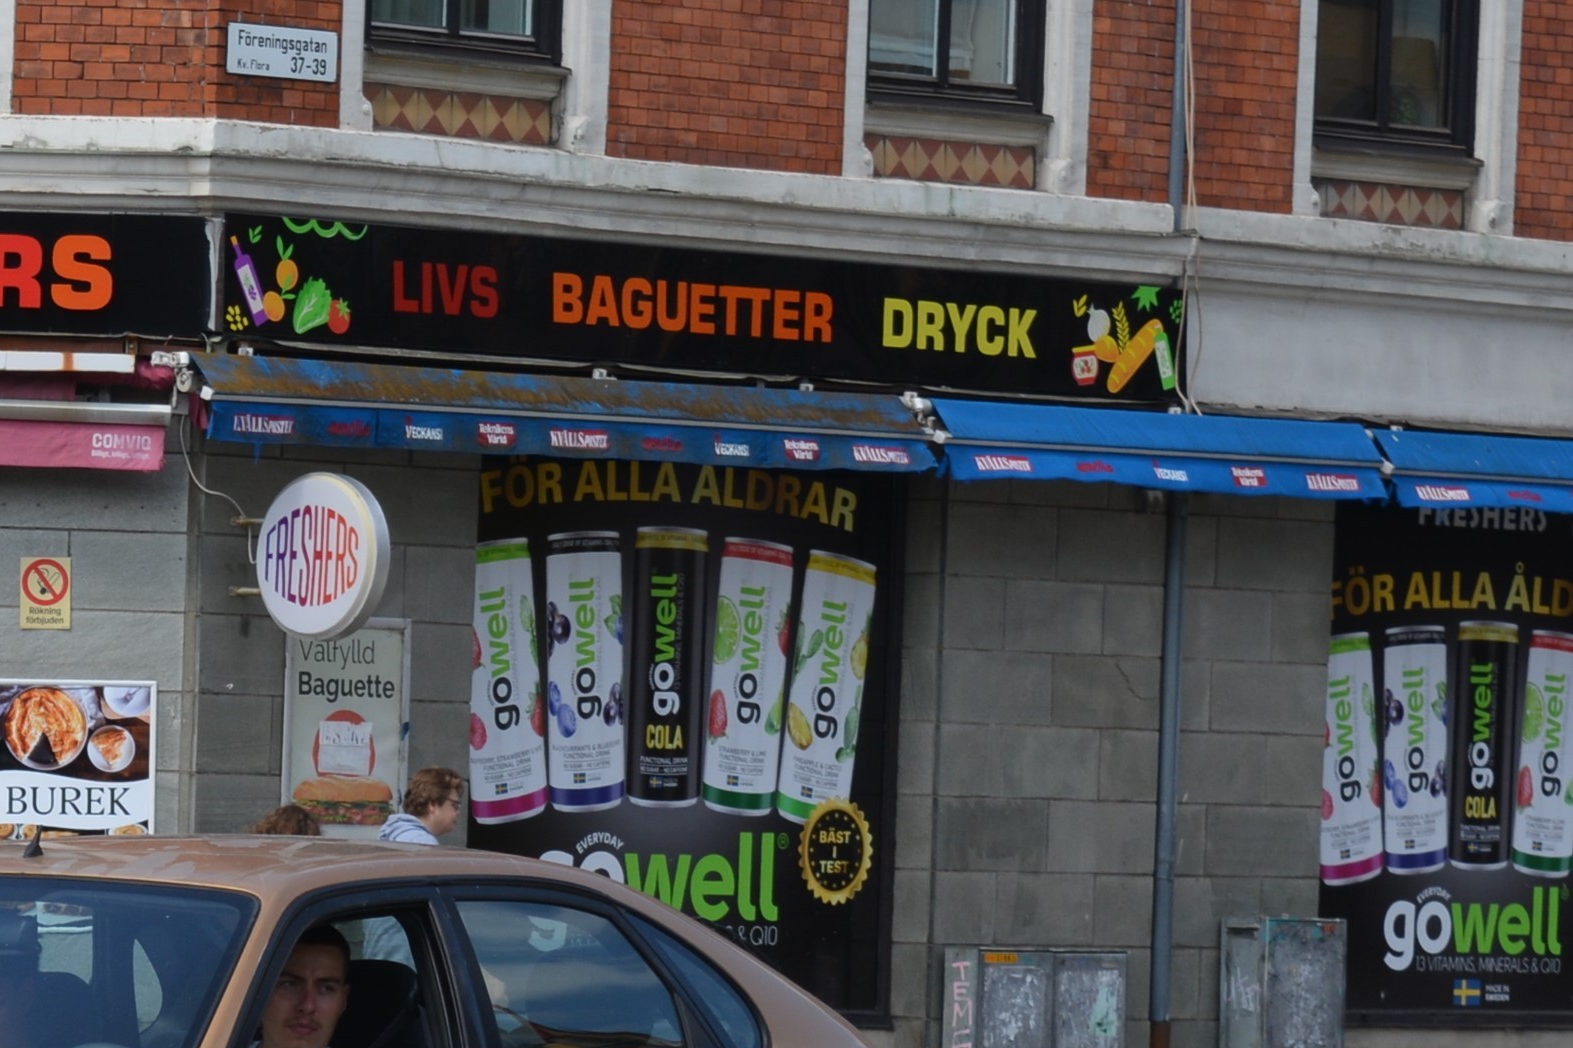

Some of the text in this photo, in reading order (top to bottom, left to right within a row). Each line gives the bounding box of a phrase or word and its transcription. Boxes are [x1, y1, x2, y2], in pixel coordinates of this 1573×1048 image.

[237, 29, 328, 56] Föreningsgatan
[250, 59, 270, 71] Flora
[290, 56, 327, 76] 37-39
[391, 260, 1038, 359] LIVS BAGUETTER DRYCK
[92, 432, 152, 451] COMVIQ
[574, 459, 682, 503] ALLA
[1418, 506, 1547, 532] FRESHERS
[264, 504, 359, 607] FRESHERS
[1404, 571, 1496, 611] ALLA
[1504, 561, 1573, 617] ÅLD
[26, 616, 64, 626] förbjuden
[28, 606, 62, 617] Rökning
[479, 586, 520, 731] gowell
[569, 577, 602, 720] gowell
[651, 573, 680, 717] gowell
[737, 586, 766, 725] gowell
[814, 601, 847, 739] gowell
[298, 671, 395, 703] Baguette
[645, 724, 683, 749] COLA
[1328, 674, 1361, 802] gowell
[1402, 667, 1430, 793] gowell
[1469, 662, 1494, 790] gowell
[1541, 674, 1566, 797] gowell
[5, 786, 130, 816] BUREK
[1465, 796, 1496, 818] COLA
[575, 831, 624, 855] EVERYDAY
[819, 827, 851, 844] BÄST
[831, 846, 837, 859] I
[819, 860, 850, 874] TEST
[1416, 886, 1452, 904] EVERYDAY
[749, 926, 778, 946] Q10
[1383, 886, 1562, 971] gowell
[1415, 955, 1425, 972] 13
[1478, 957, 1529, 973] MINERALS
[1531, 958, 1539, 973] &
